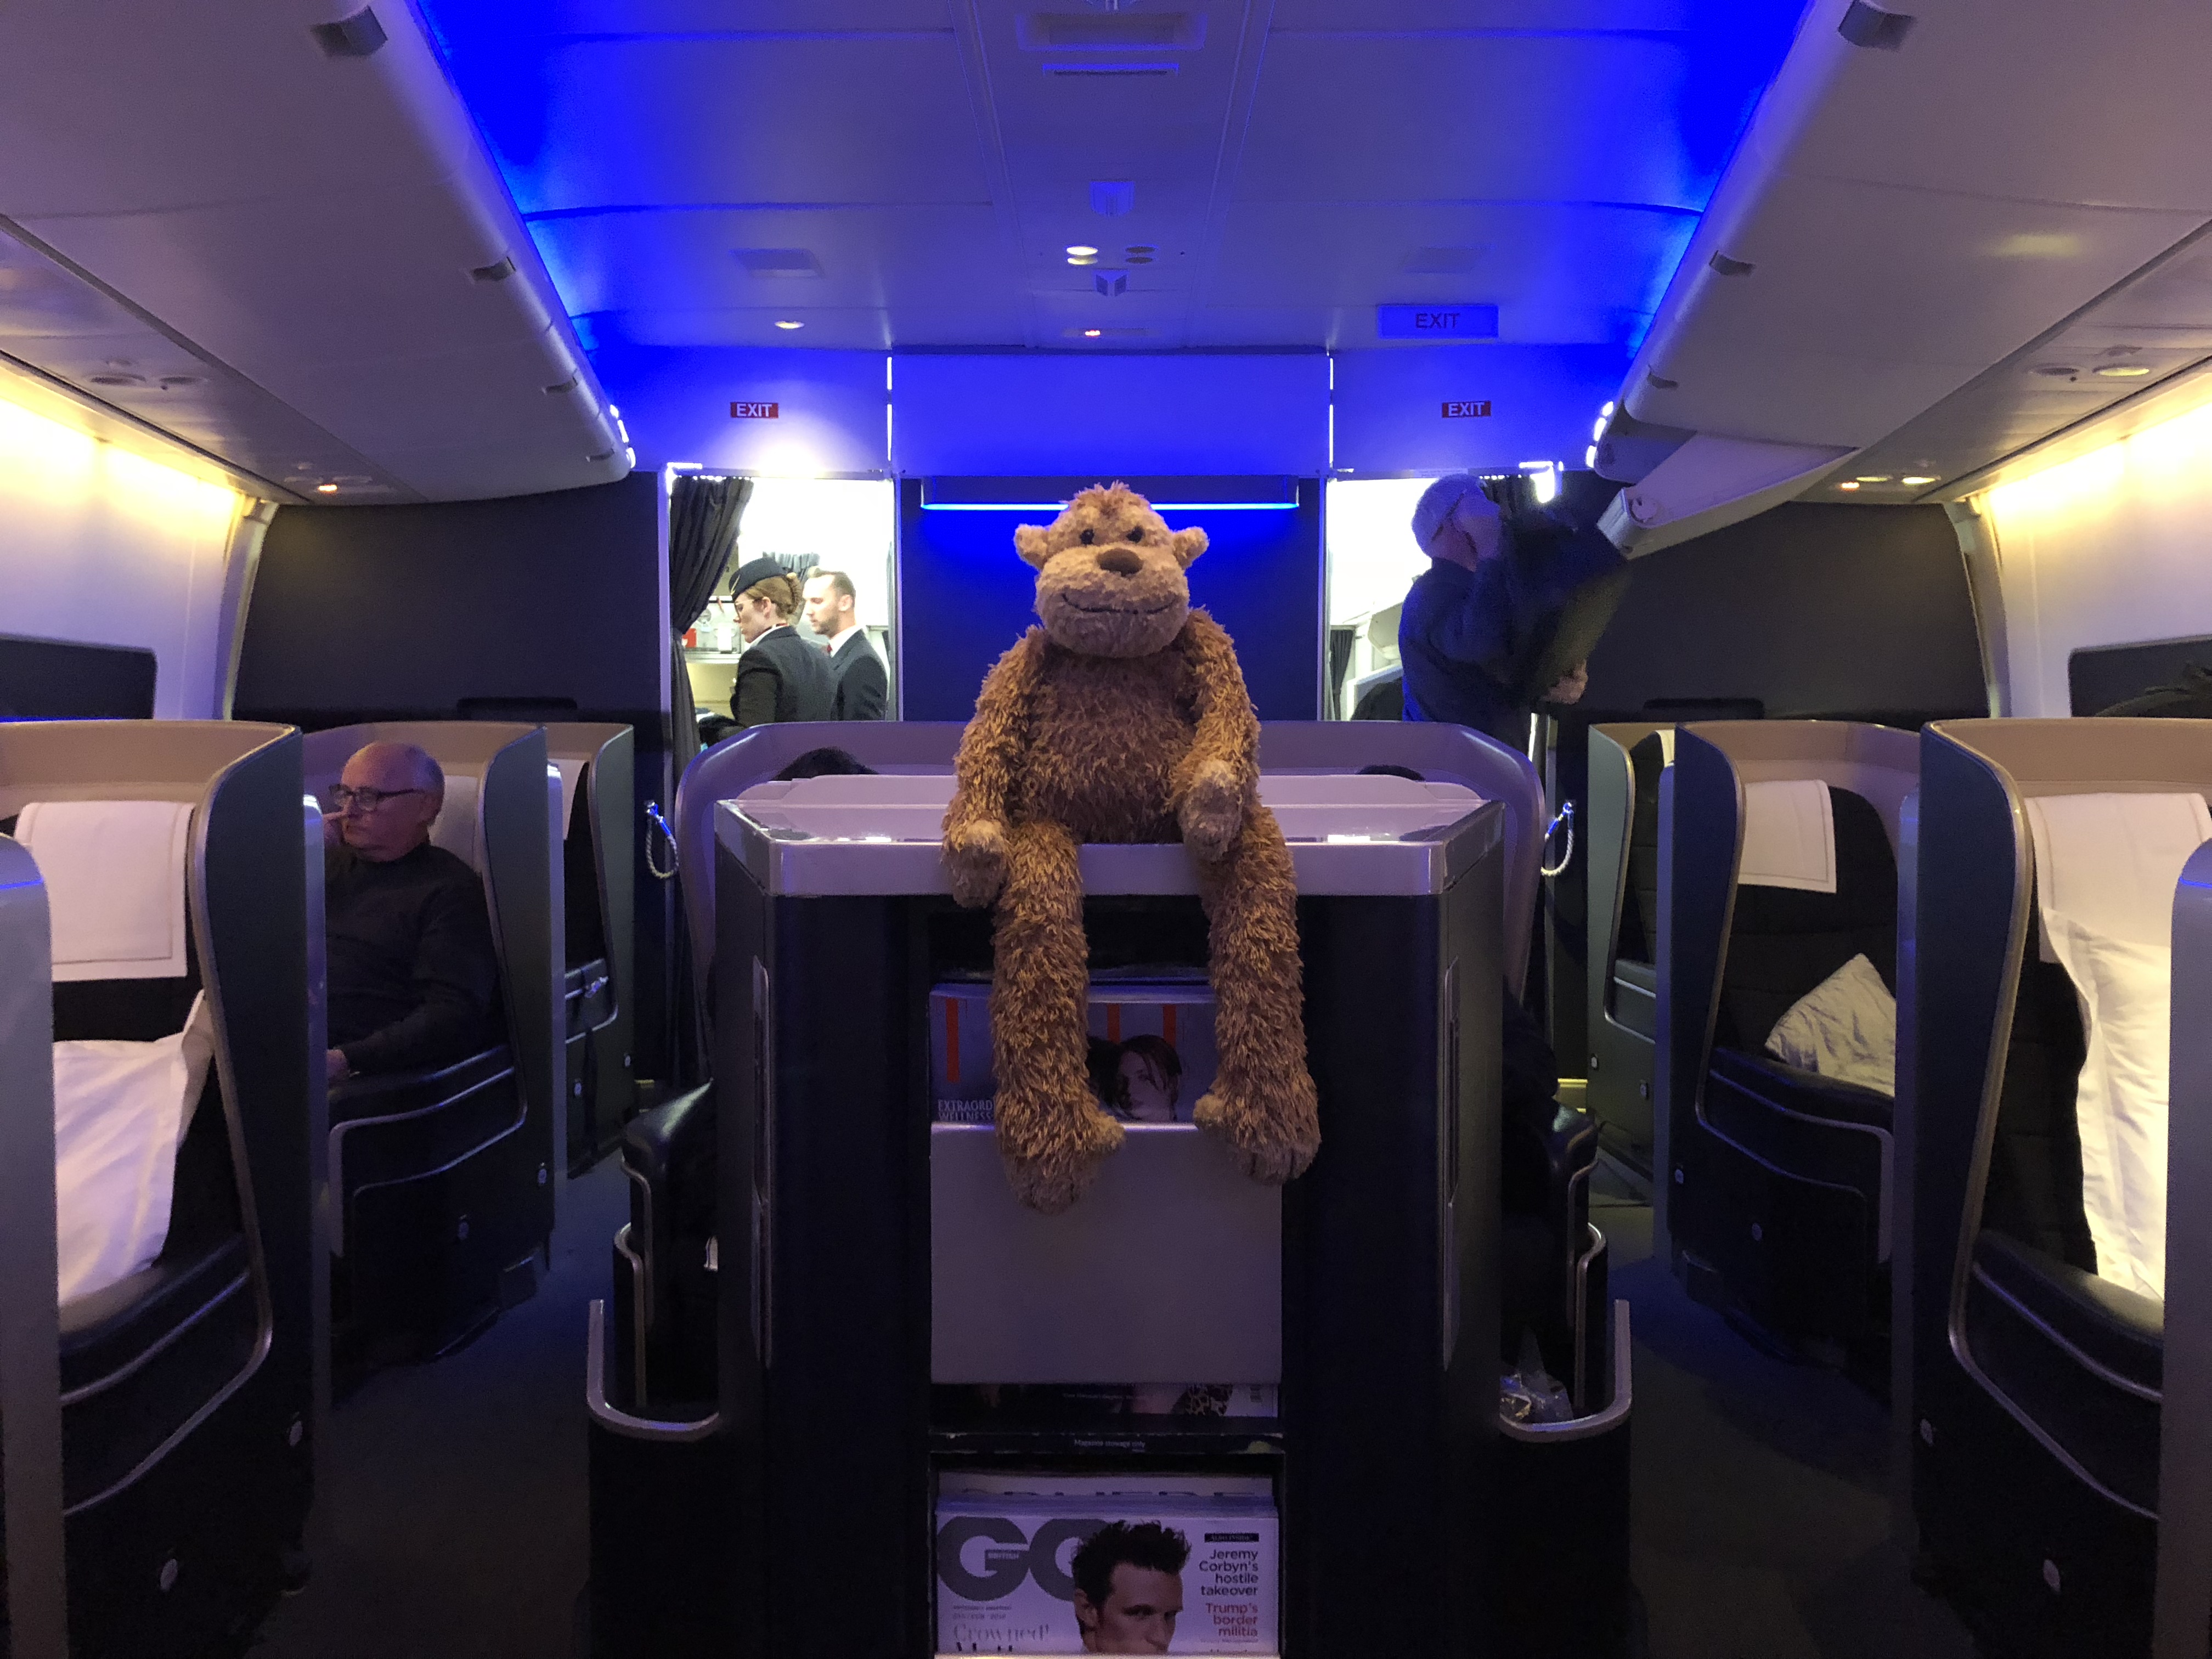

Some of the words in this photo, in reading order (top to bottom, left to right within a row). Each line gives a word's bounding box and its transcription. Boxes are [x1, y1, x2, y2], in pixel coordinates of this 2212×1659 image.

[1415, 312, 1460, 329] EXIT
[736, 403, 772, 417] EXIT
[1447, 402, 1485, 417] EXIT
[938, 1099, 993, 1111] EXTRAORD
[1209, 1549, 1259, 1562] Jeremy
[1199, 1560, 1259, 1573] Corbyn's
[1215, 1573, 1259, 1584] hostile
[1200, 1585, 1258, 1596] takeover
[1205, 1602, 1259, 1615] Trump's
[1213, 1615, 1258, 1625] border
[1218, 1626, 1259, 1637] militia
